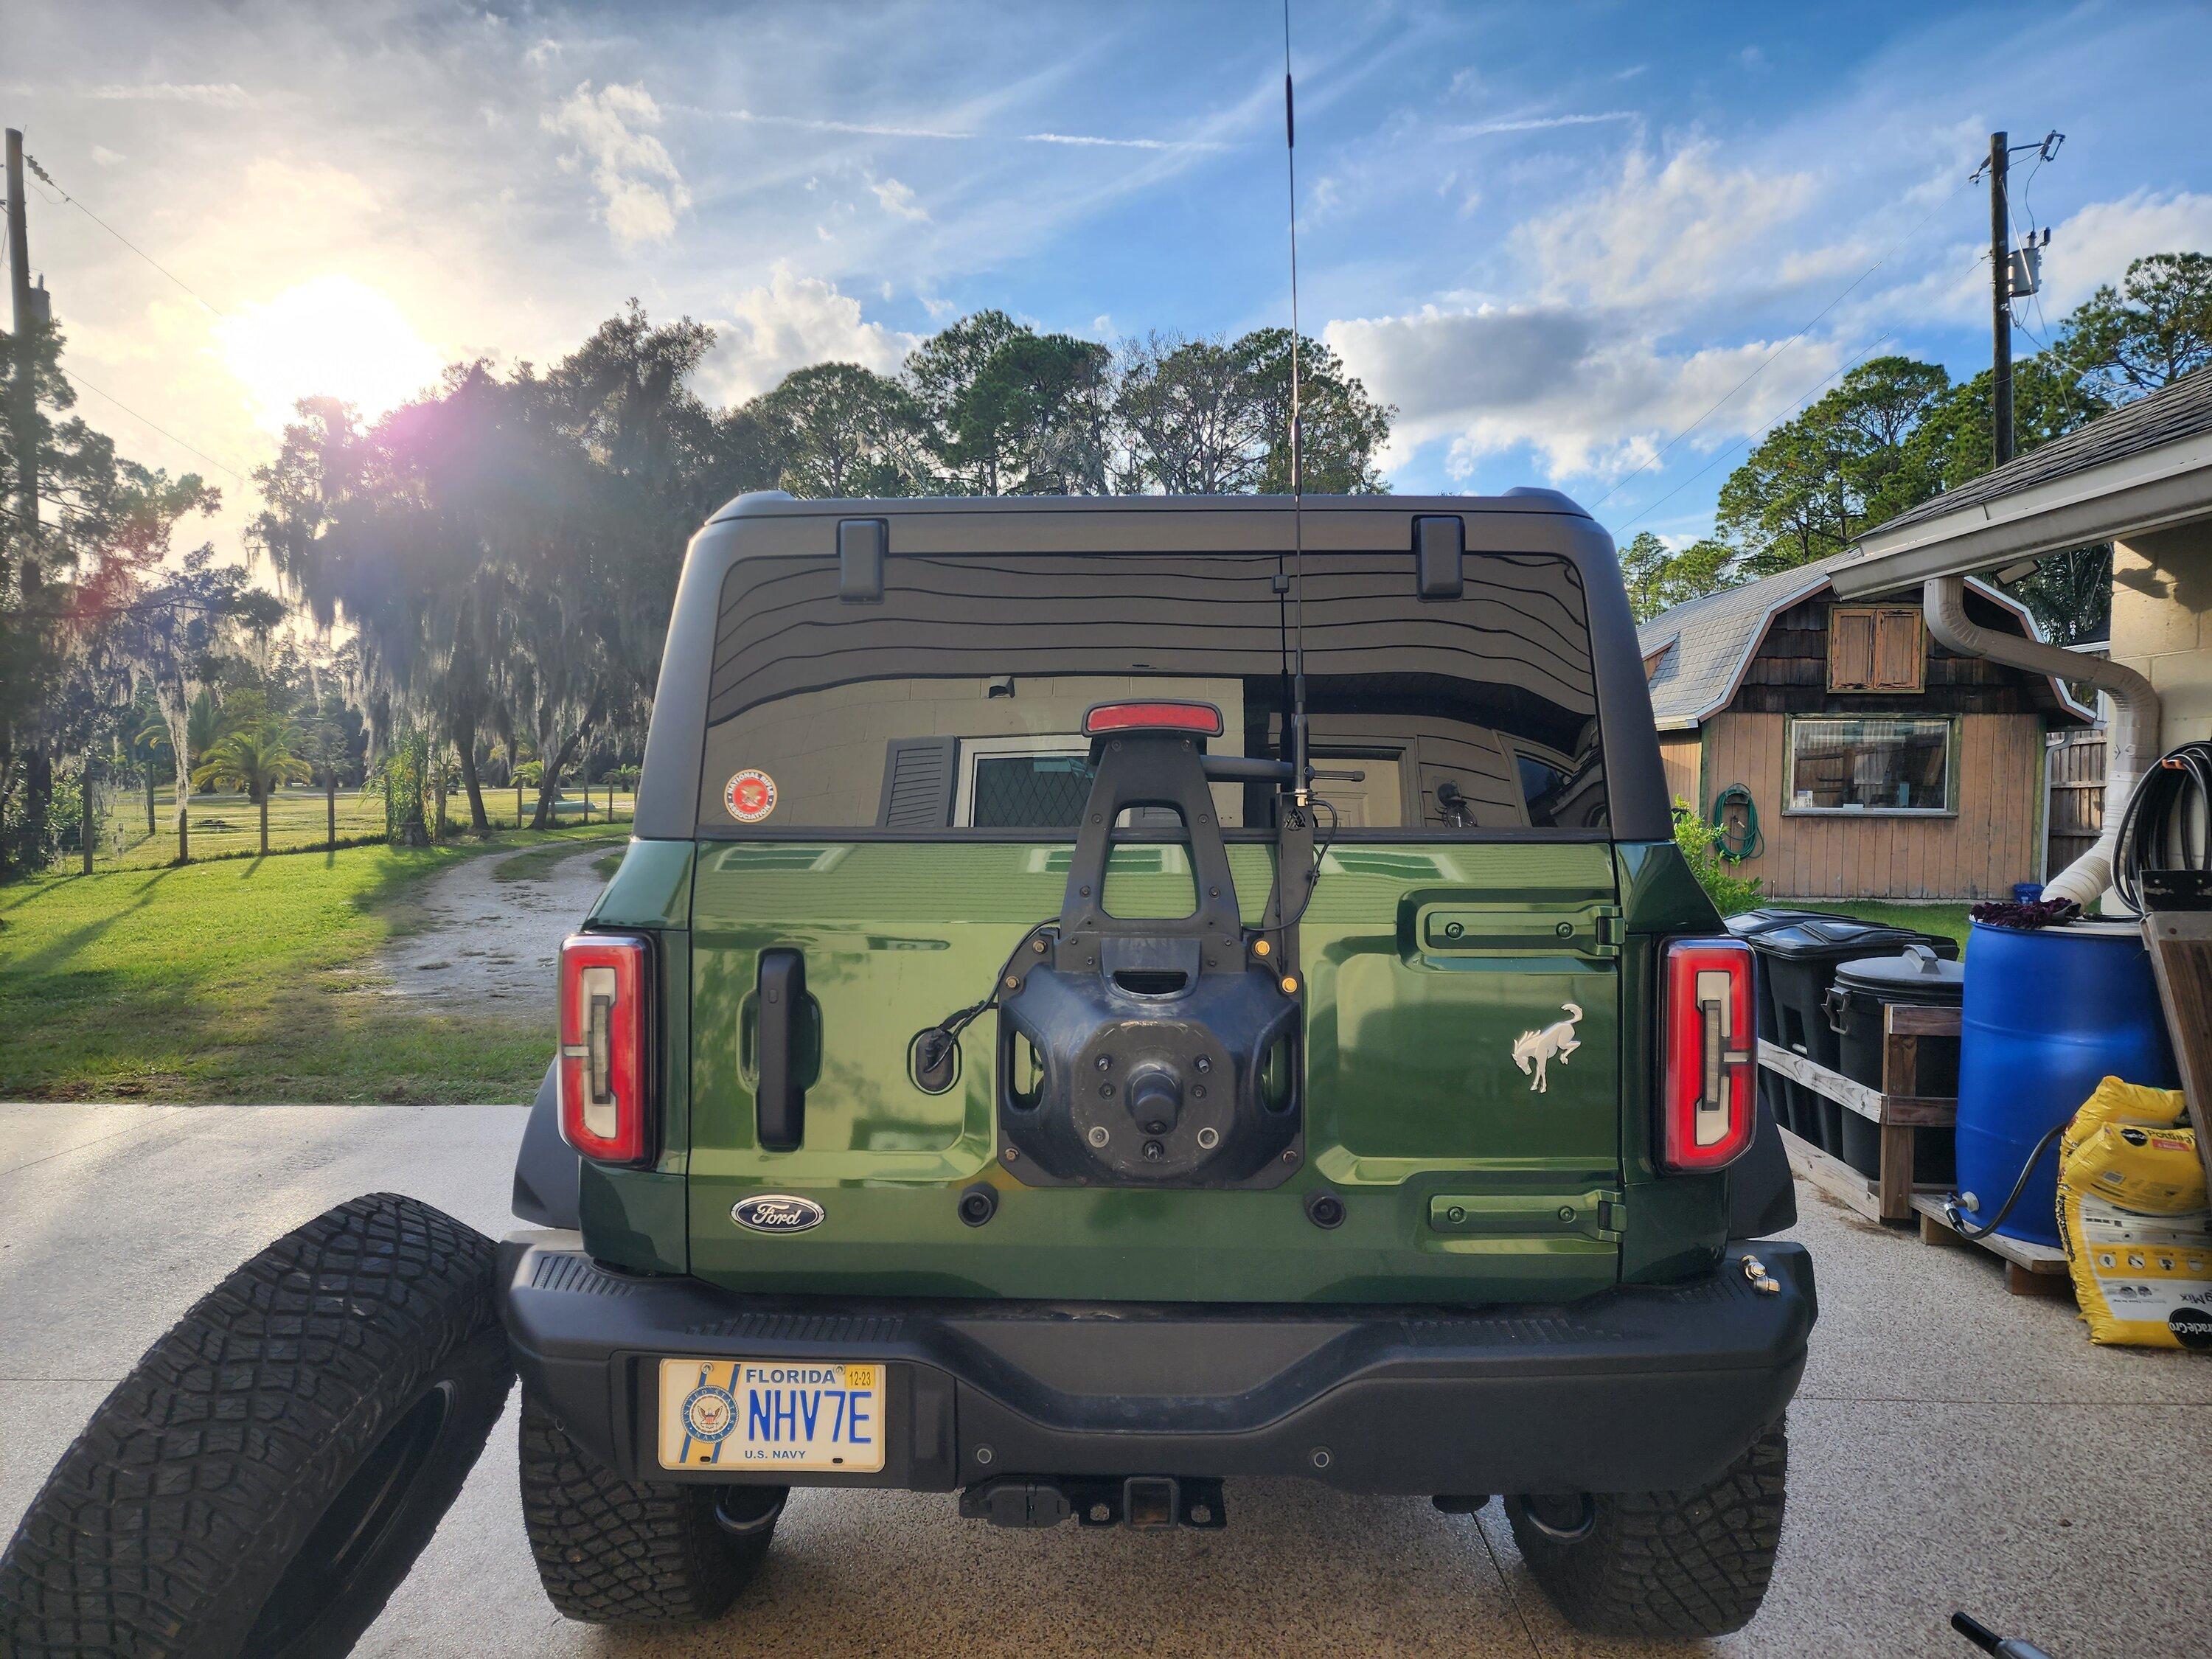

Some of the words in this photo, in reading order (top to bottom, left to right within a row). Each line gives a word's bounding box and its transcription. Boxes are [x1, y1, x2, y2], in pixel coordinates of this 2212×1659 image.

[728, 802, 771, 820] ASSOCIATION
[751, 1203, 801, 1225] Ford
[745, 1369, 836, 1385] FLORIDA
[684, 1389, 707, 1424] UNITED
[714, 1389, 736, 1424] STATES
[748, 1389, 872, 1444] NHV7E
[695, 1431, 723, 1441] NAVY
[745, 1450, 768, 1459] U.S.
[772, 1450, 807, 1459] NAVY
